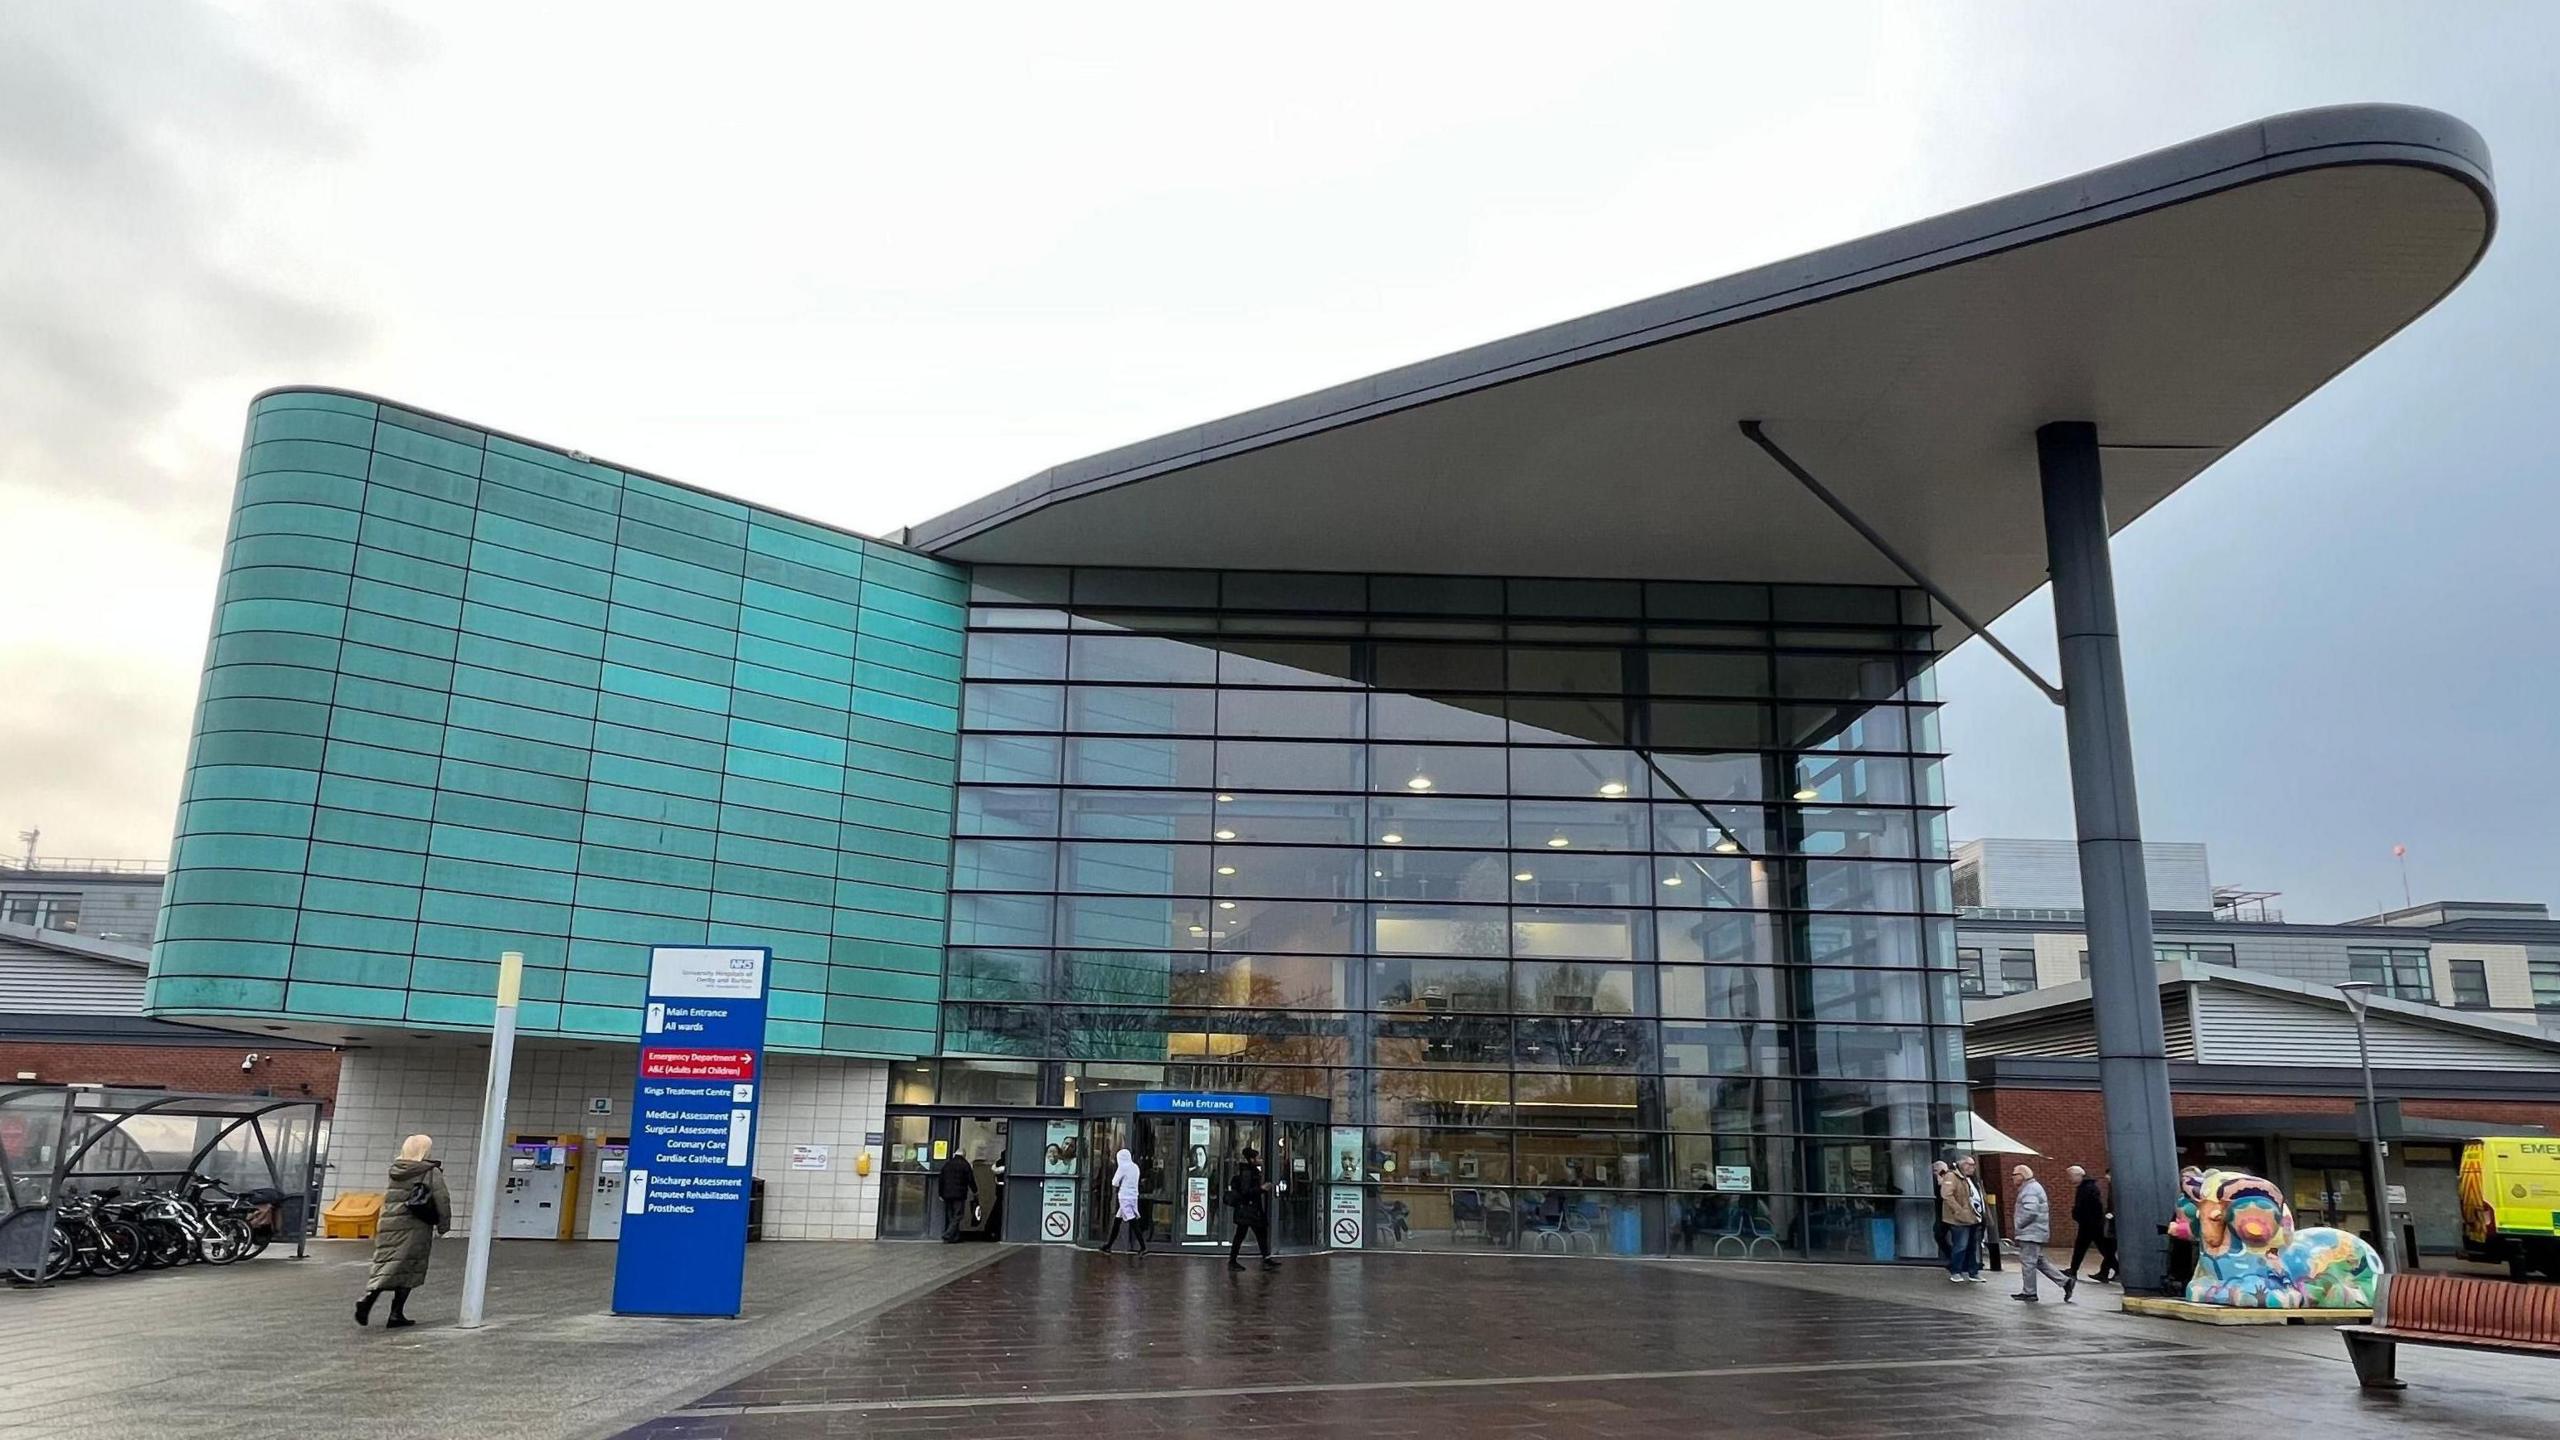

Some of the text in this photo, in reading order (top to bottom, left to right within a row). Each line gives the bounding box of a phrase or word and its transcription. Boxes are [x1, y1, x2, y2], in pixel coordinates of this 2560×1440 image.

[731, 960, 753, 969] NHS
[666, 1007, 728, 1018] Main Entrance
[665, 1022, 704, 1031] All wards
[648, 1052, 737, 1063] Emergency Department
[648, 1065, 740, 1077] A&E (Adults and Children)
[644, 1086, 731, 1097] Kings Treatment Centre
[1172, 1099, 1234, 1109] Main Entrance
[645, 1110, 728, 1121] Medical Assessment
[645, 1124, 728, 1135] Surgical Assessment
[667, 1139, 727, 1150] Coronary Care
[2520, 1144, 2560, 1155] EME
[656, 1153, 725, 1164] Cardiac Catheter
[651, 1176, 742, 1187] Discharge Assessment
[649, 1190, 739, 1200] Amputee Rehabilitation
[648, 1203, 694, 1213] Prosthetics
